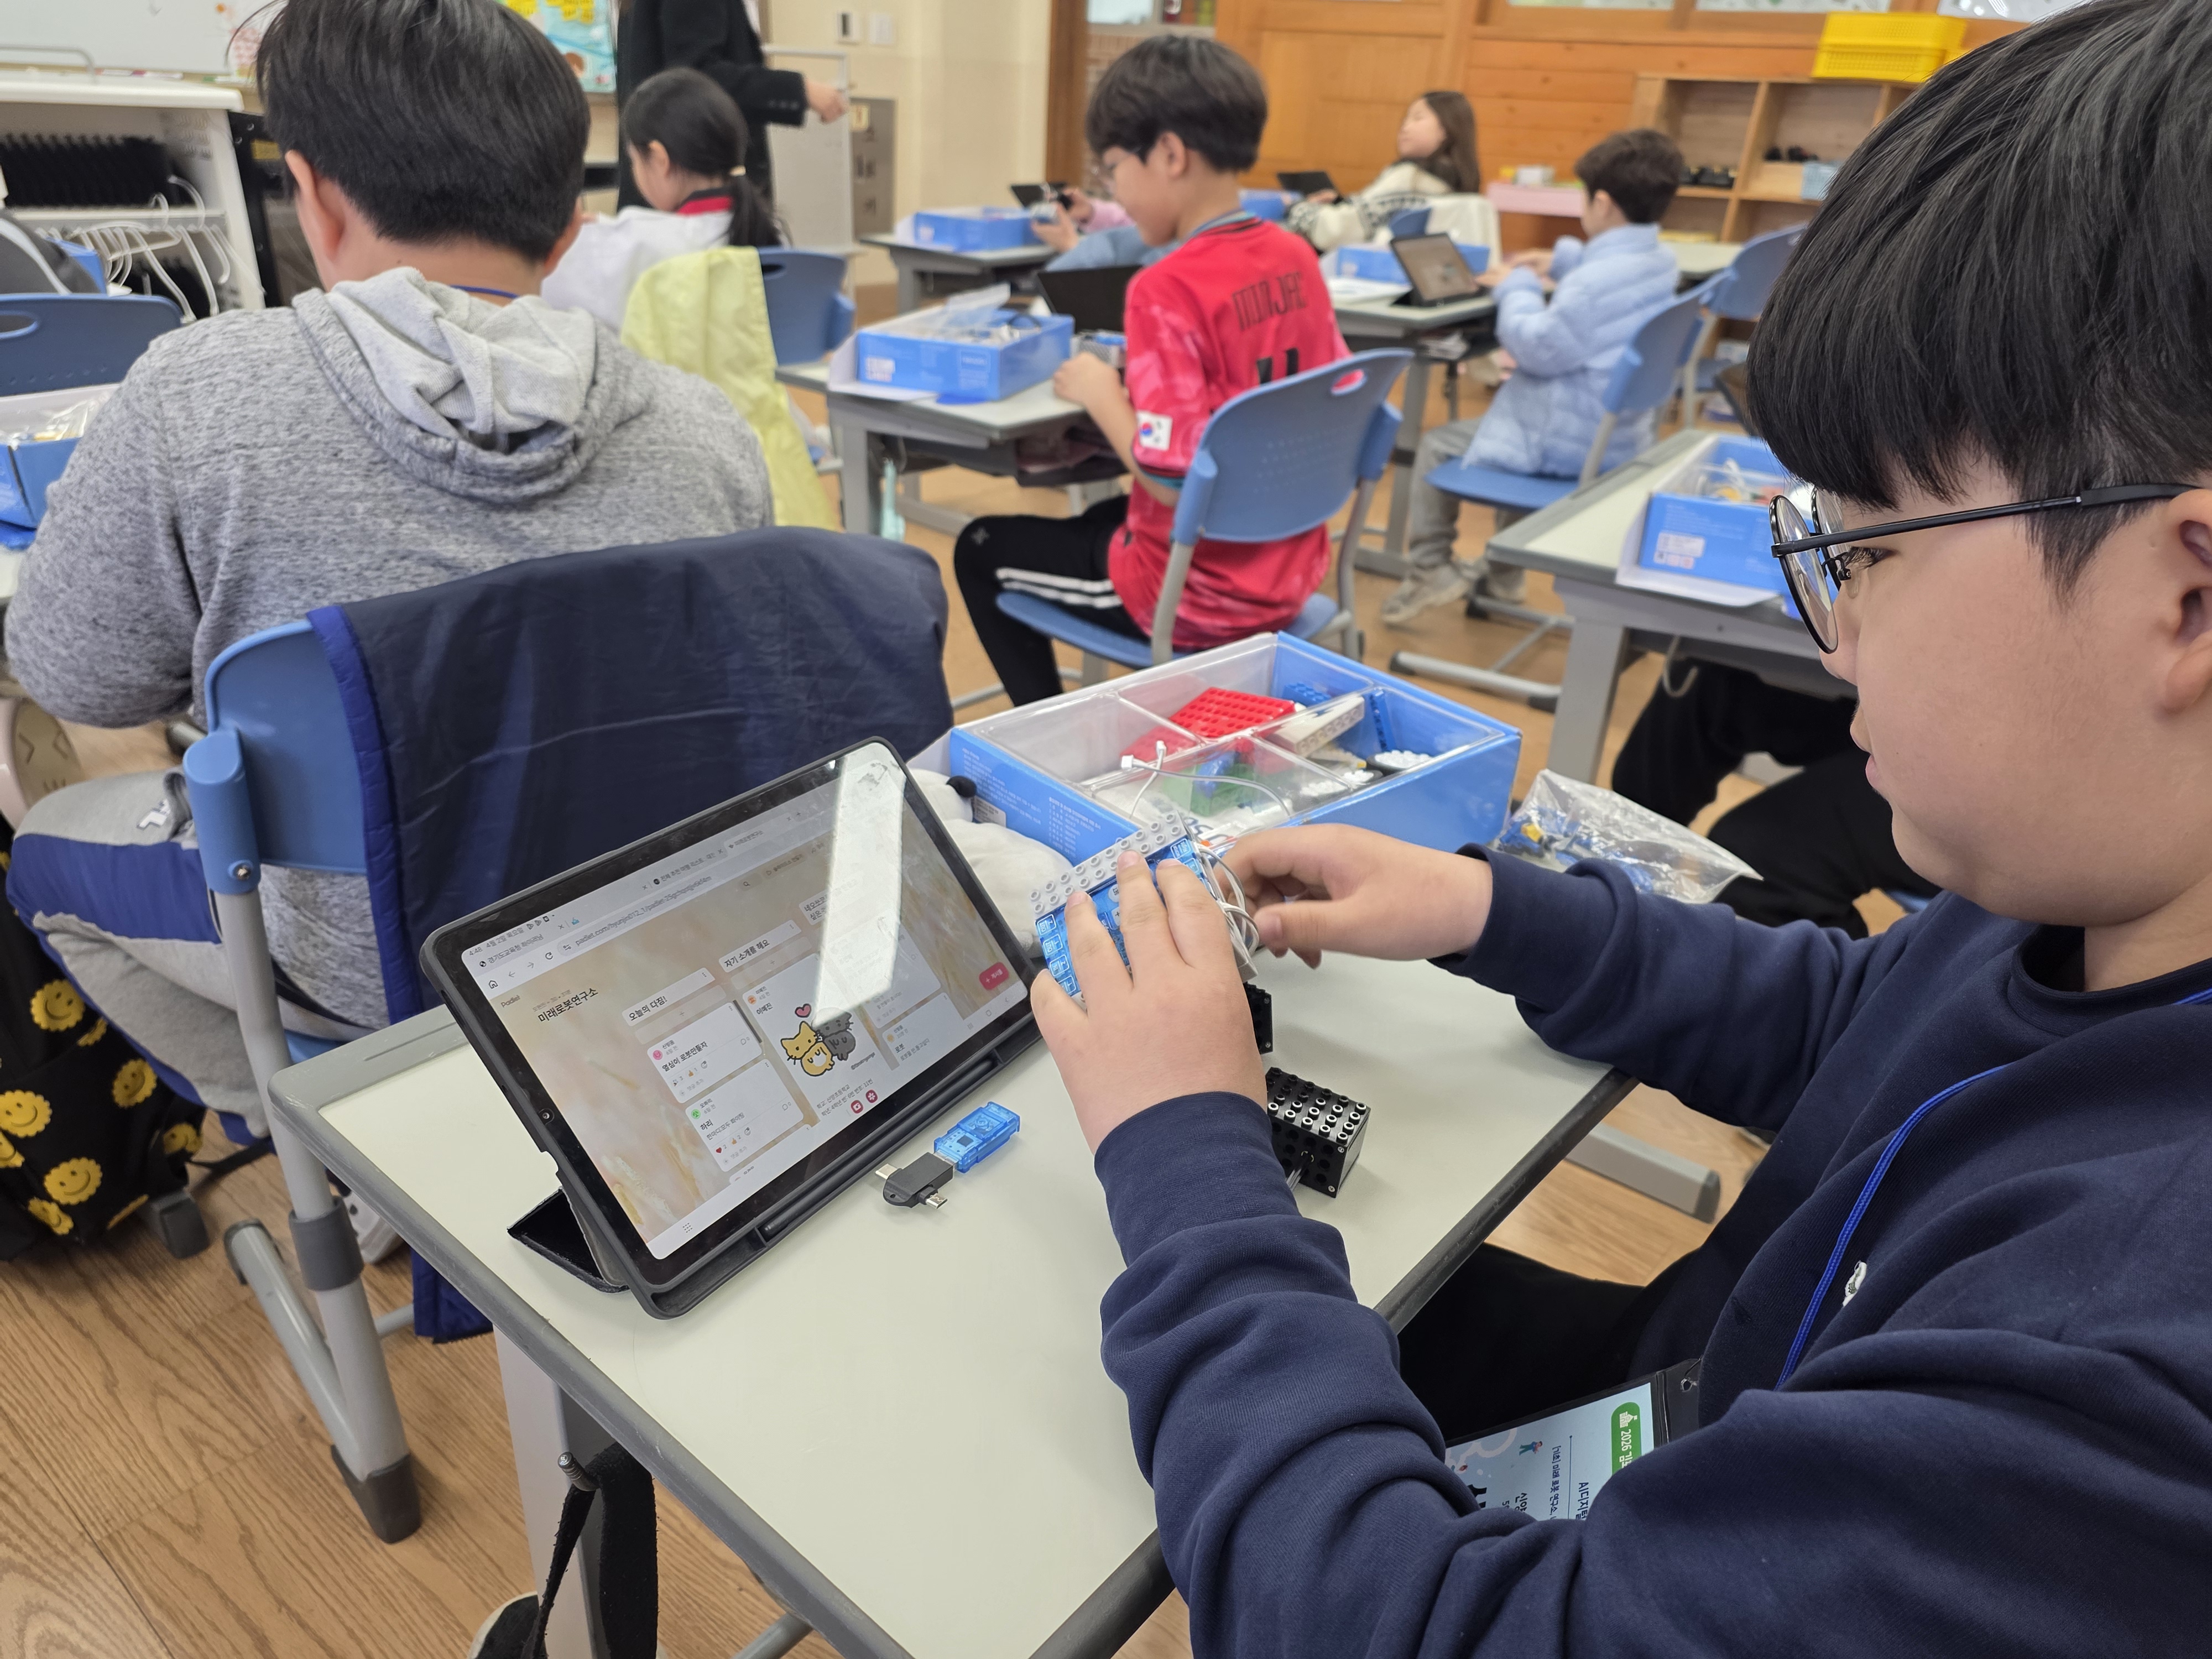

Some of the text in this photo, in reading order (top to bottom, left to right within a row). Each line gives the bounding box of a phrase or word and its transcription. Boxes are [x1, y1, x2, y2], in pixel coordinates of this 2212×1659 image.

[1110, 884, 1120, 896] SET
[1038, 921, 1047, 932] OUT
[468, 947, 482, 956] 4:48
[1044, 941, 1053, 952] OUT
[724, 938, 770, 968] 자기 소개를 해요
[501, 995, 520, 1007] Padlet
[538, 987, 598, 1022] 미래로봇연구소
[628, 995, 667, 1020] 오늘의 다짐!
[895, 1044, 905, 1053] 로봇
[662, 1041, 707, 1071] 열심이 로봇만들자
[700, 1119, 713, 1131] 하리
[1621, 1428, 1632, 1451] 2026
[1550, 1446, 1561, 1515] [기초] 미래 로봇 연구소,
